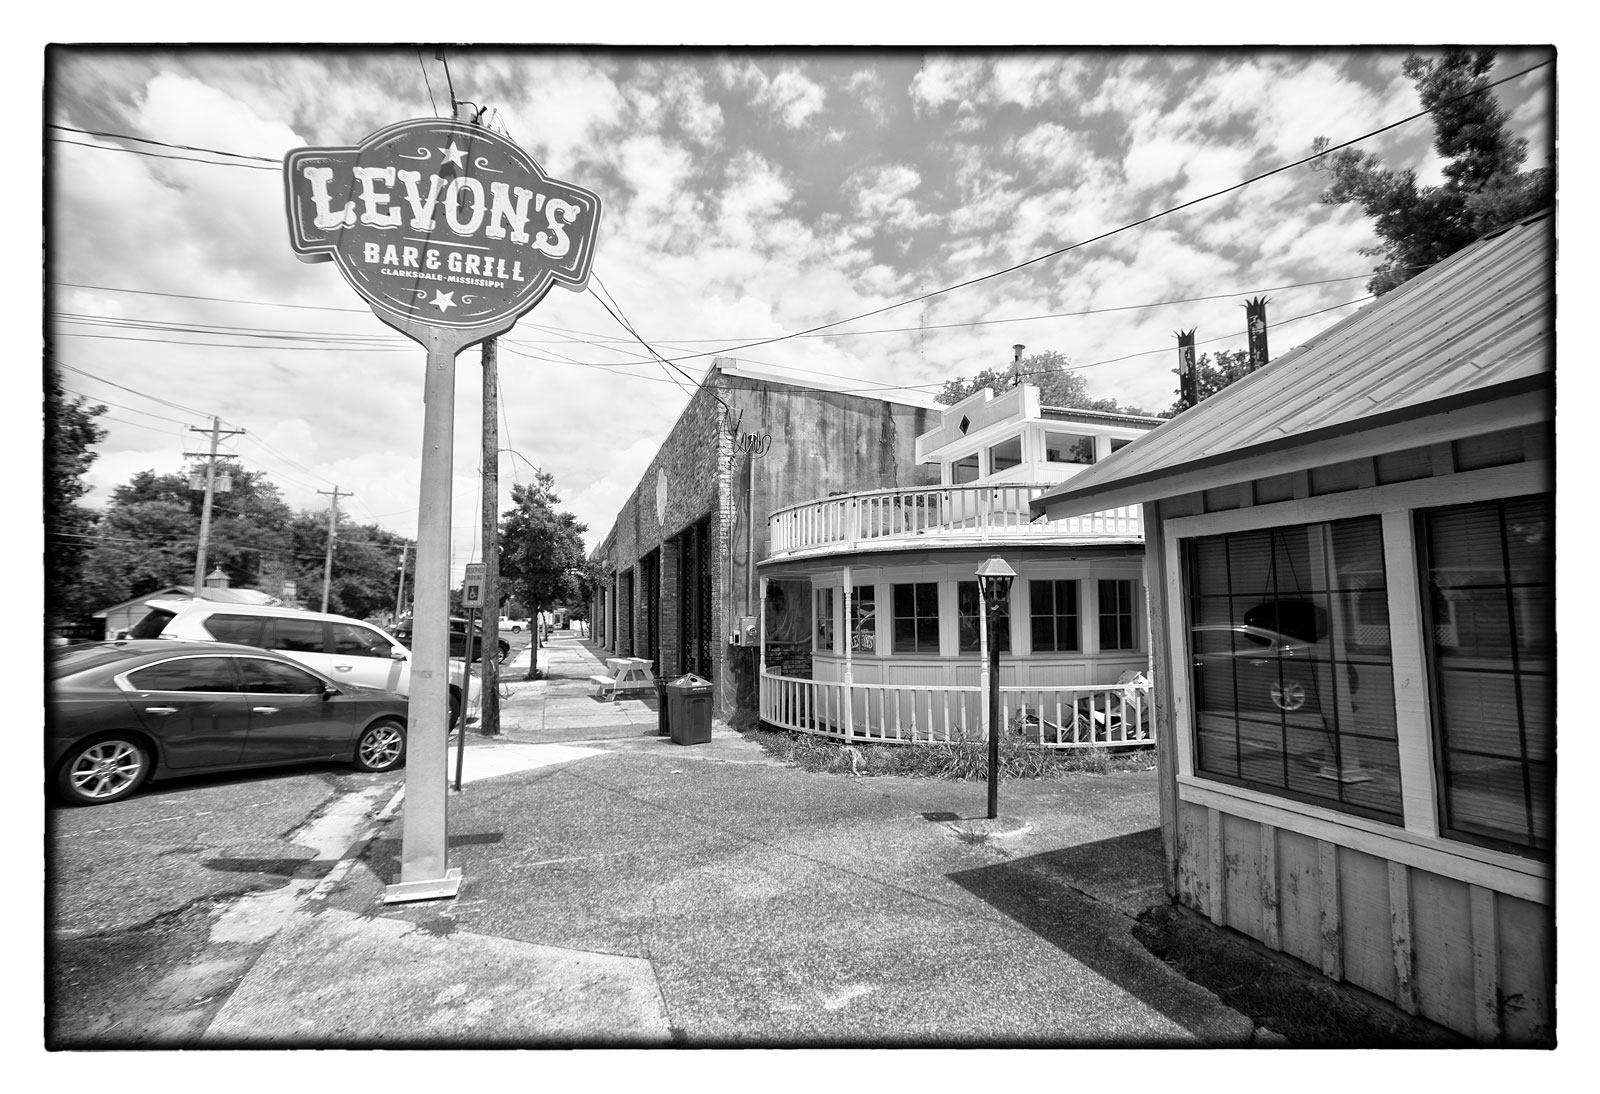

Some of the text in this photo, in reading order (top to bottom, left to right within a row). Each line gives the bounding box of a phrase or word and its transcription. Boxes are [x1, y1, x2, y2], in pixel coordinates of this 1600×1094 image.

[303, 166, 581, 257] LEVON'S
[363, 242, 525, 282] BAR & GRILL
